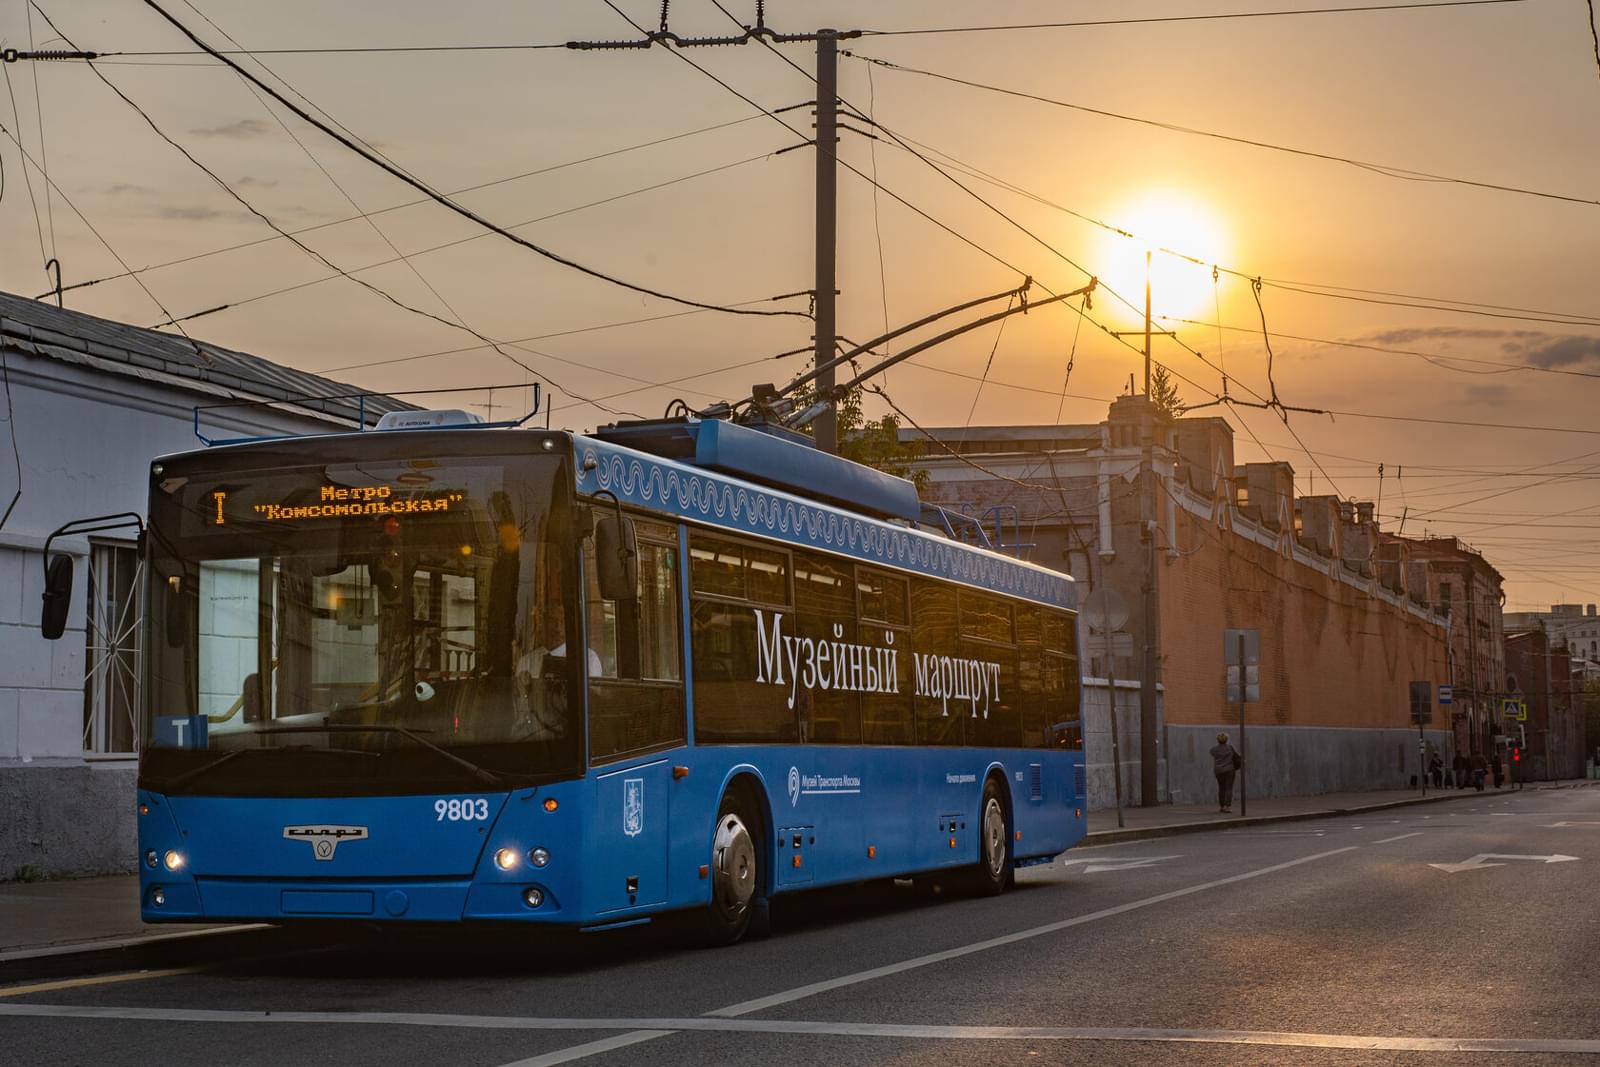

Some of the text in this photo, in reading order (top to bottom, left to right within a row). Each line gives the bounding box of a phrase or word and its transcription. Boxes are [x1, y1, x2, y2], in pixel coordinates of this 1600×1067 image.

[321, 486, 391, 501] Метро
[254, 494, 464, 520] "Комсомольская"
[753, 609, 1001, 720] Музейный маршрут
[434, 799, 489, 821] 9803
